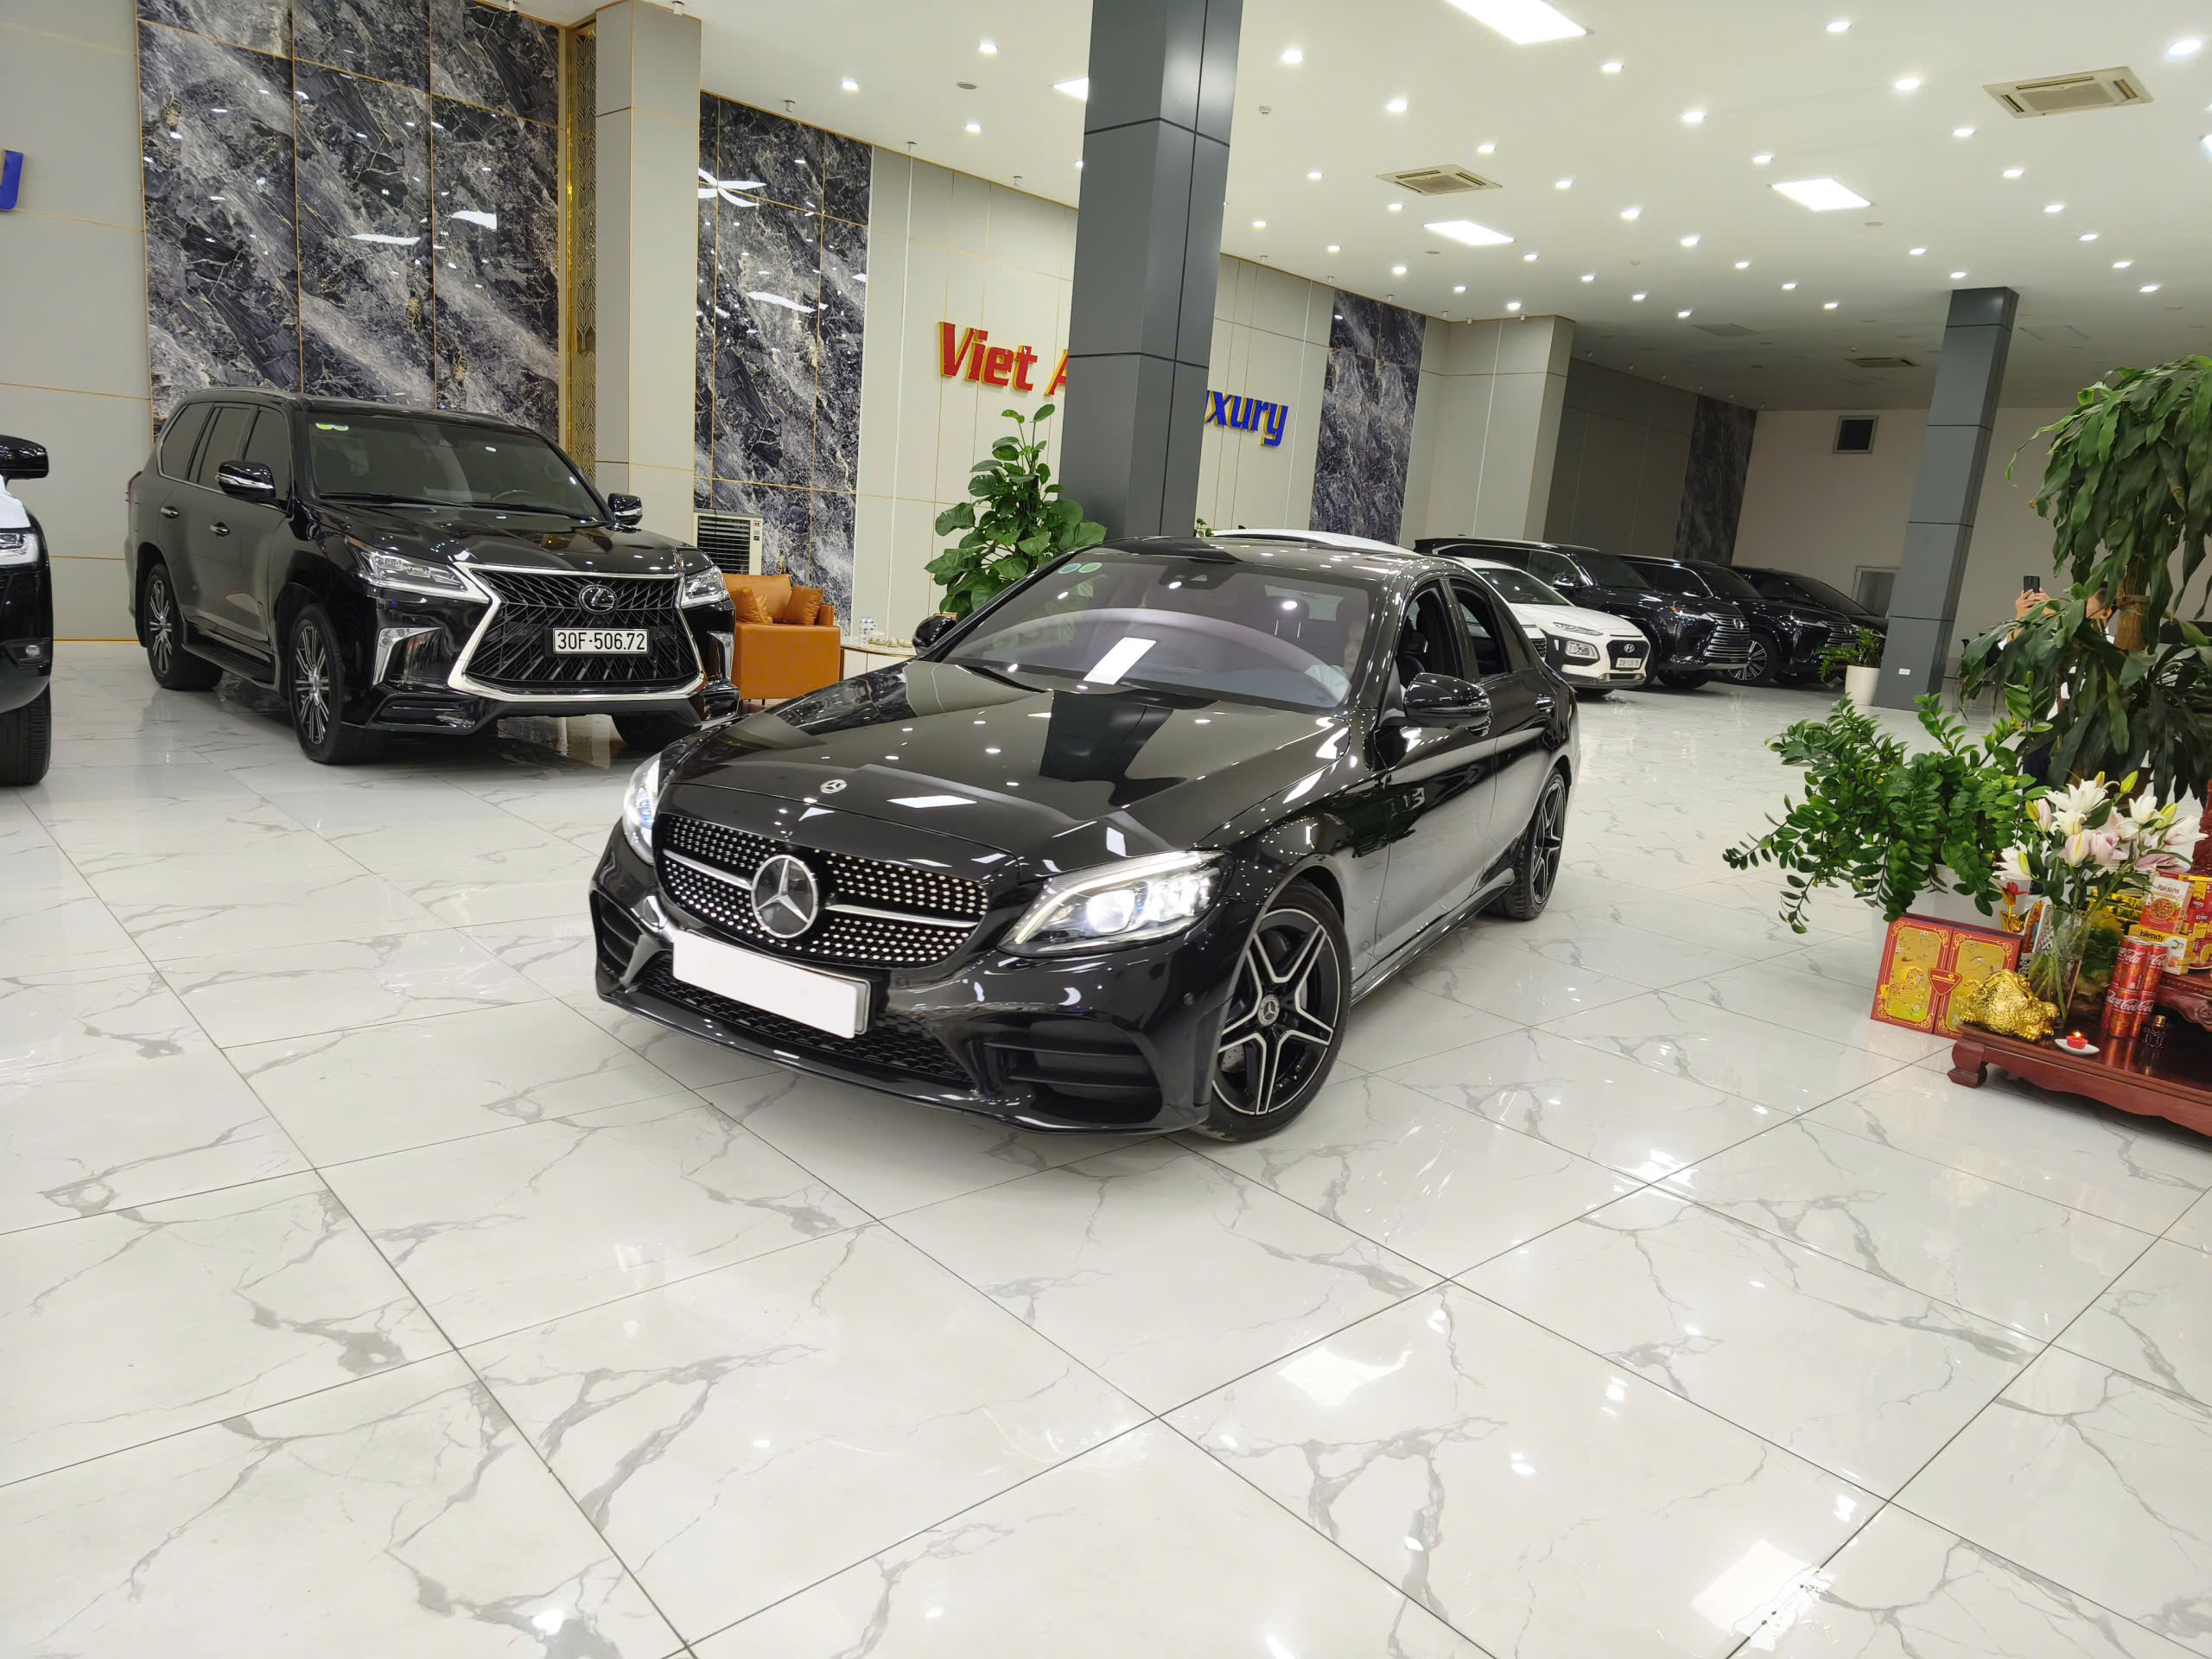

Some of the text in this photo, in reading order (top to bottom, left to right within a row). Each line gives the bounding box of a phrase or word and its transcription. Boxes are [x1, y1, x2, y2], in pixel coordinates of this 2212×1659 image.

[939, 321, 1038, 391] Viet
[1204, 390, 1289, 447] xury
[557, 632, 645, 651] 30F-506.72
[2158, 884, 2180, 894] Raisins
